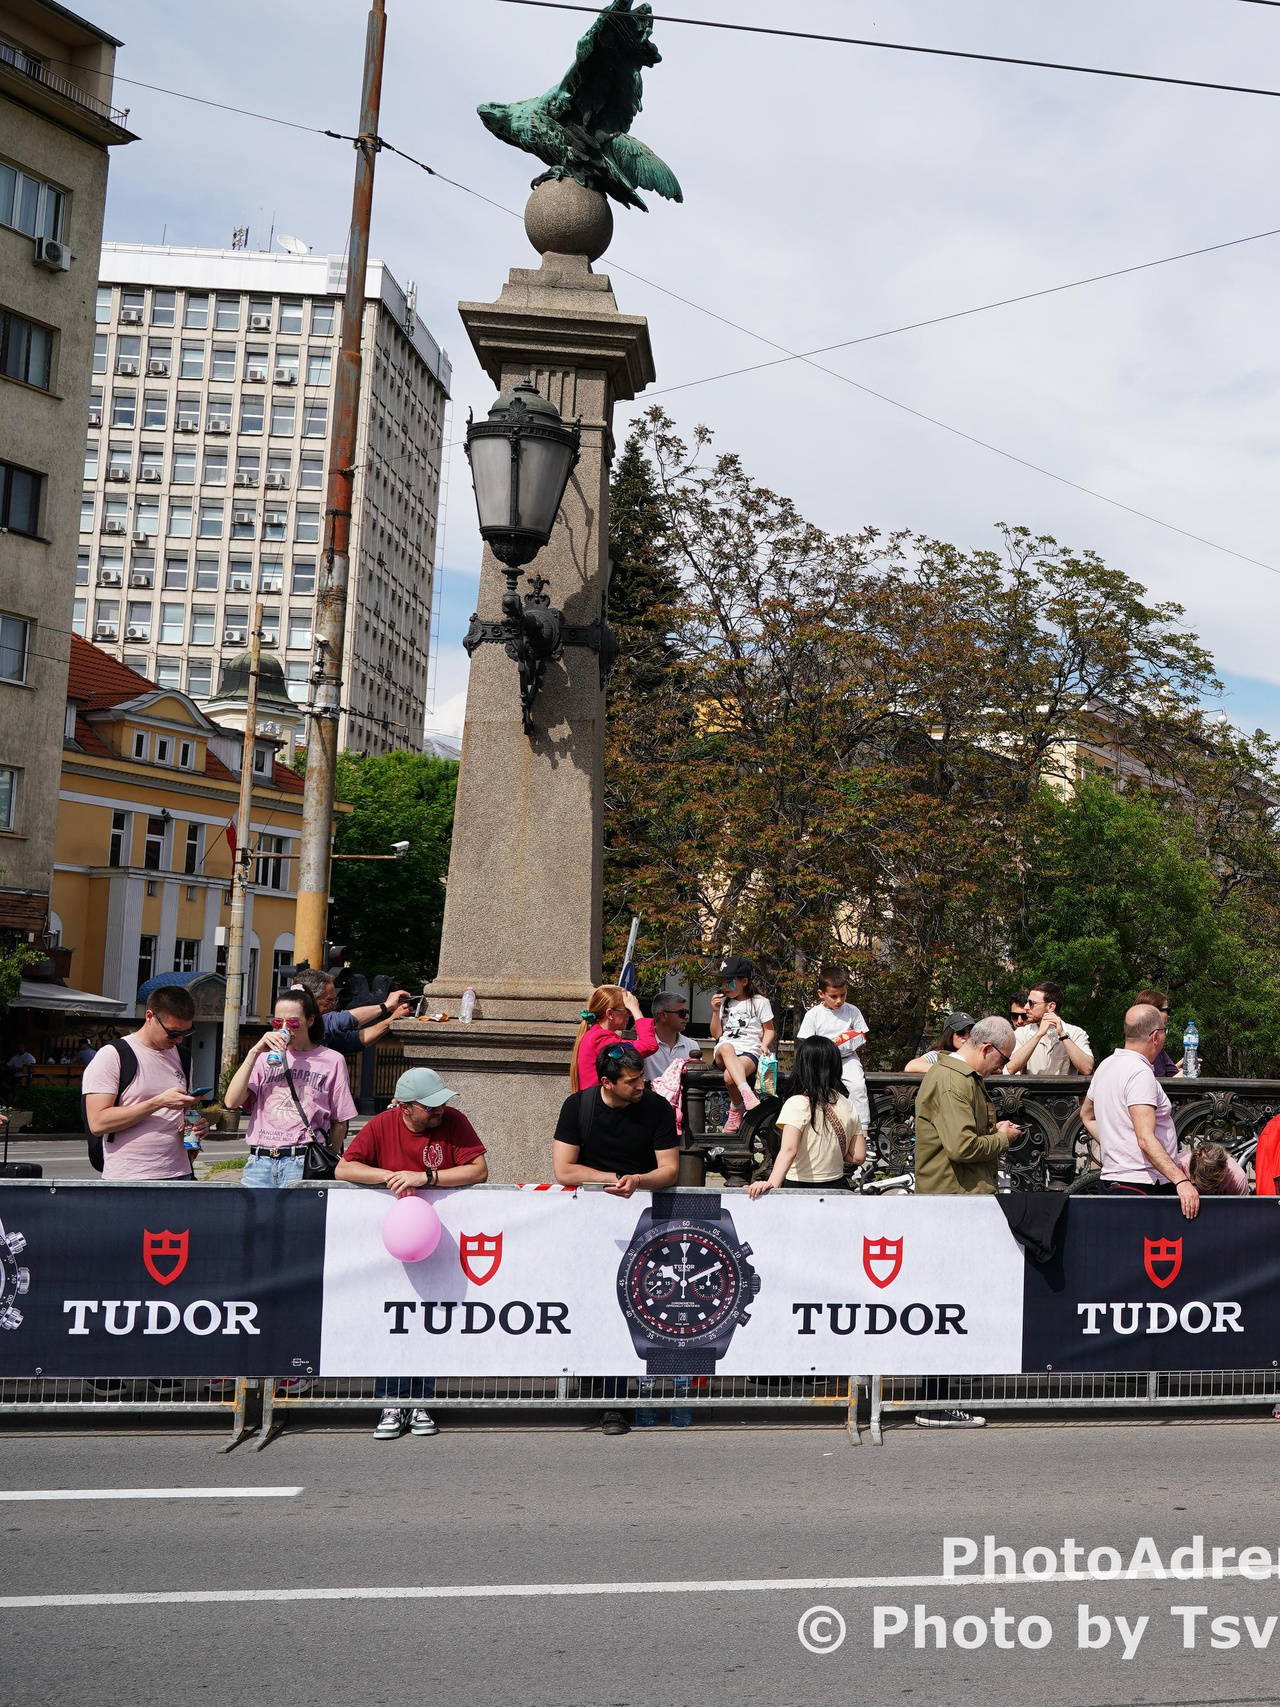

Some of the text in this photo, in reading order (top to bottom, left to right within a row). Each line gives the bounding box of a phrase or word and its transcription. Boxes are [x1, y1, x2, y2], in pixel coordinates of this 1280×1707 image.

[63, 1300, 261, 1336] TUDOR
[384, 1301, 571, 1336] TUDOR
[792, 1302, 968, 1336] TUDOR
[1077, 1301, 1245, 1335] TUDOR
